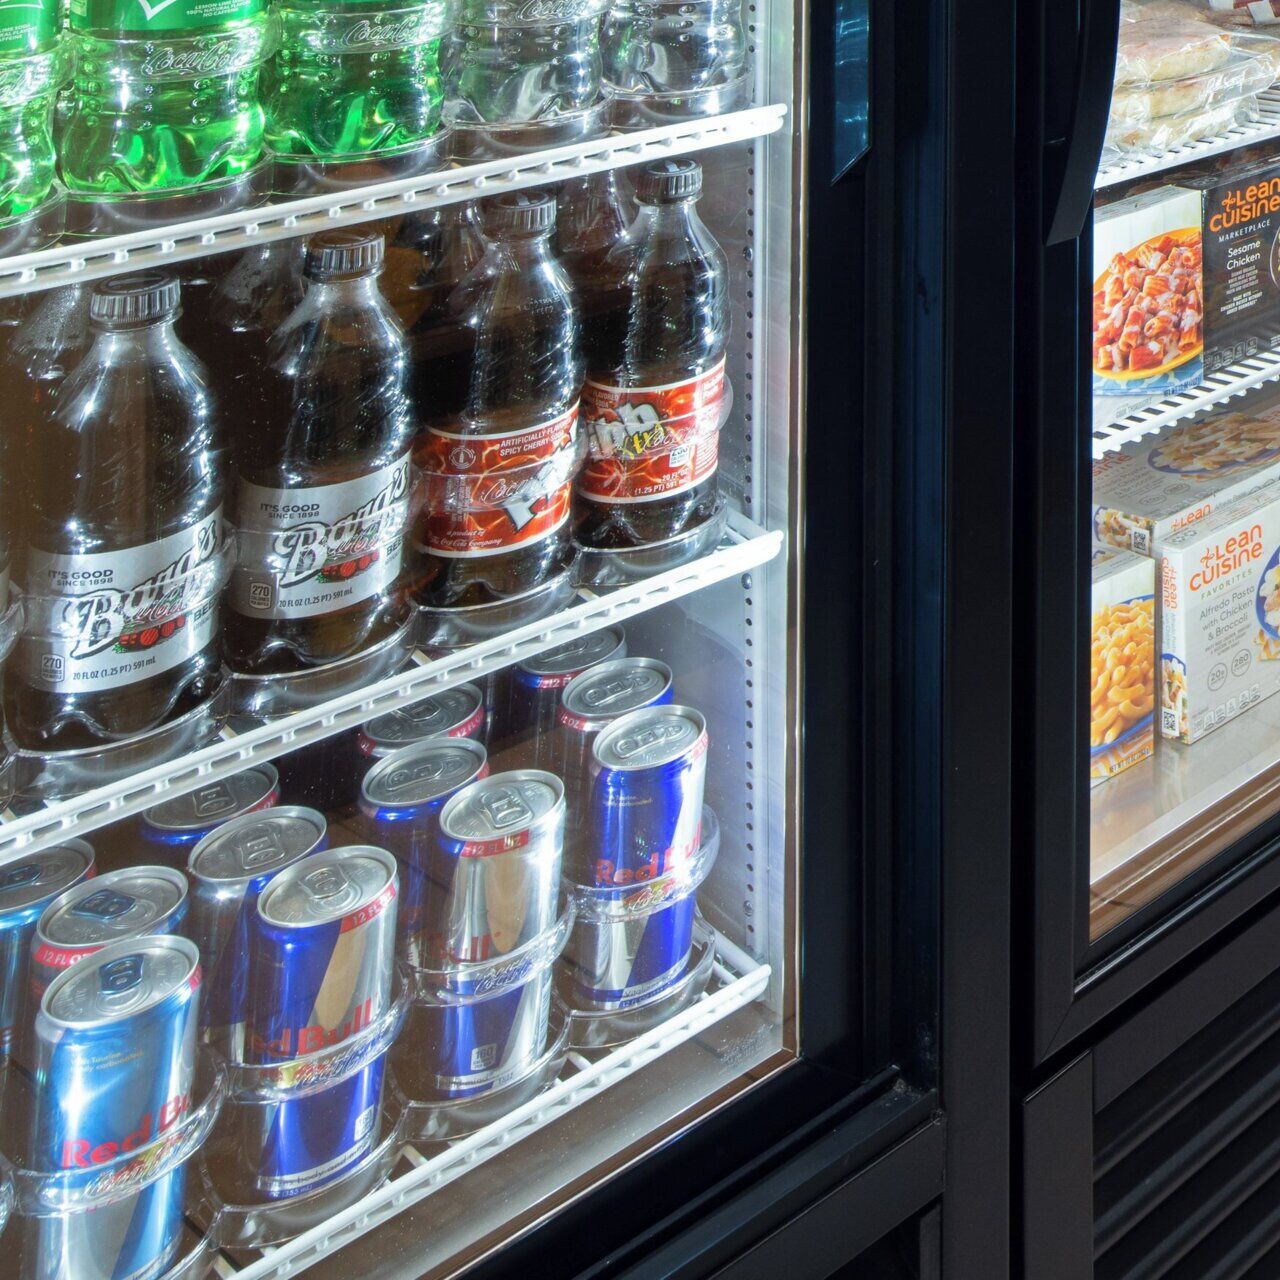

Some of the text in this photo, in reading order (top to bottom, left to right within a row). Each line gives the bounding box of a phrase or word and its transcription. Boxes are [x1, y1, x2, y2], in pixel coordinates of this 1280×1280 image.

[1218, 219, 1271, 243] MARKETPLACE
[1227, 239, 1261, 258] Sesame
[1226, 252, 1261, 271] Chicken
[282, 503, 320, 513] GOOD
[1181, 504, 1210, 527] Lean
[1214, 524, 1262, 559] Lean
[71, 569, 114, 579] GOOD
[1201, 568, 1253, 600] FAVORITES
[1200, 585, 1255, 619] Alfredo Pasta
[1202, 599, 1253, 632] with Chicken
[1215, 613, 1248, 639] Broccoli
[596, 852, 658, 884] Red
